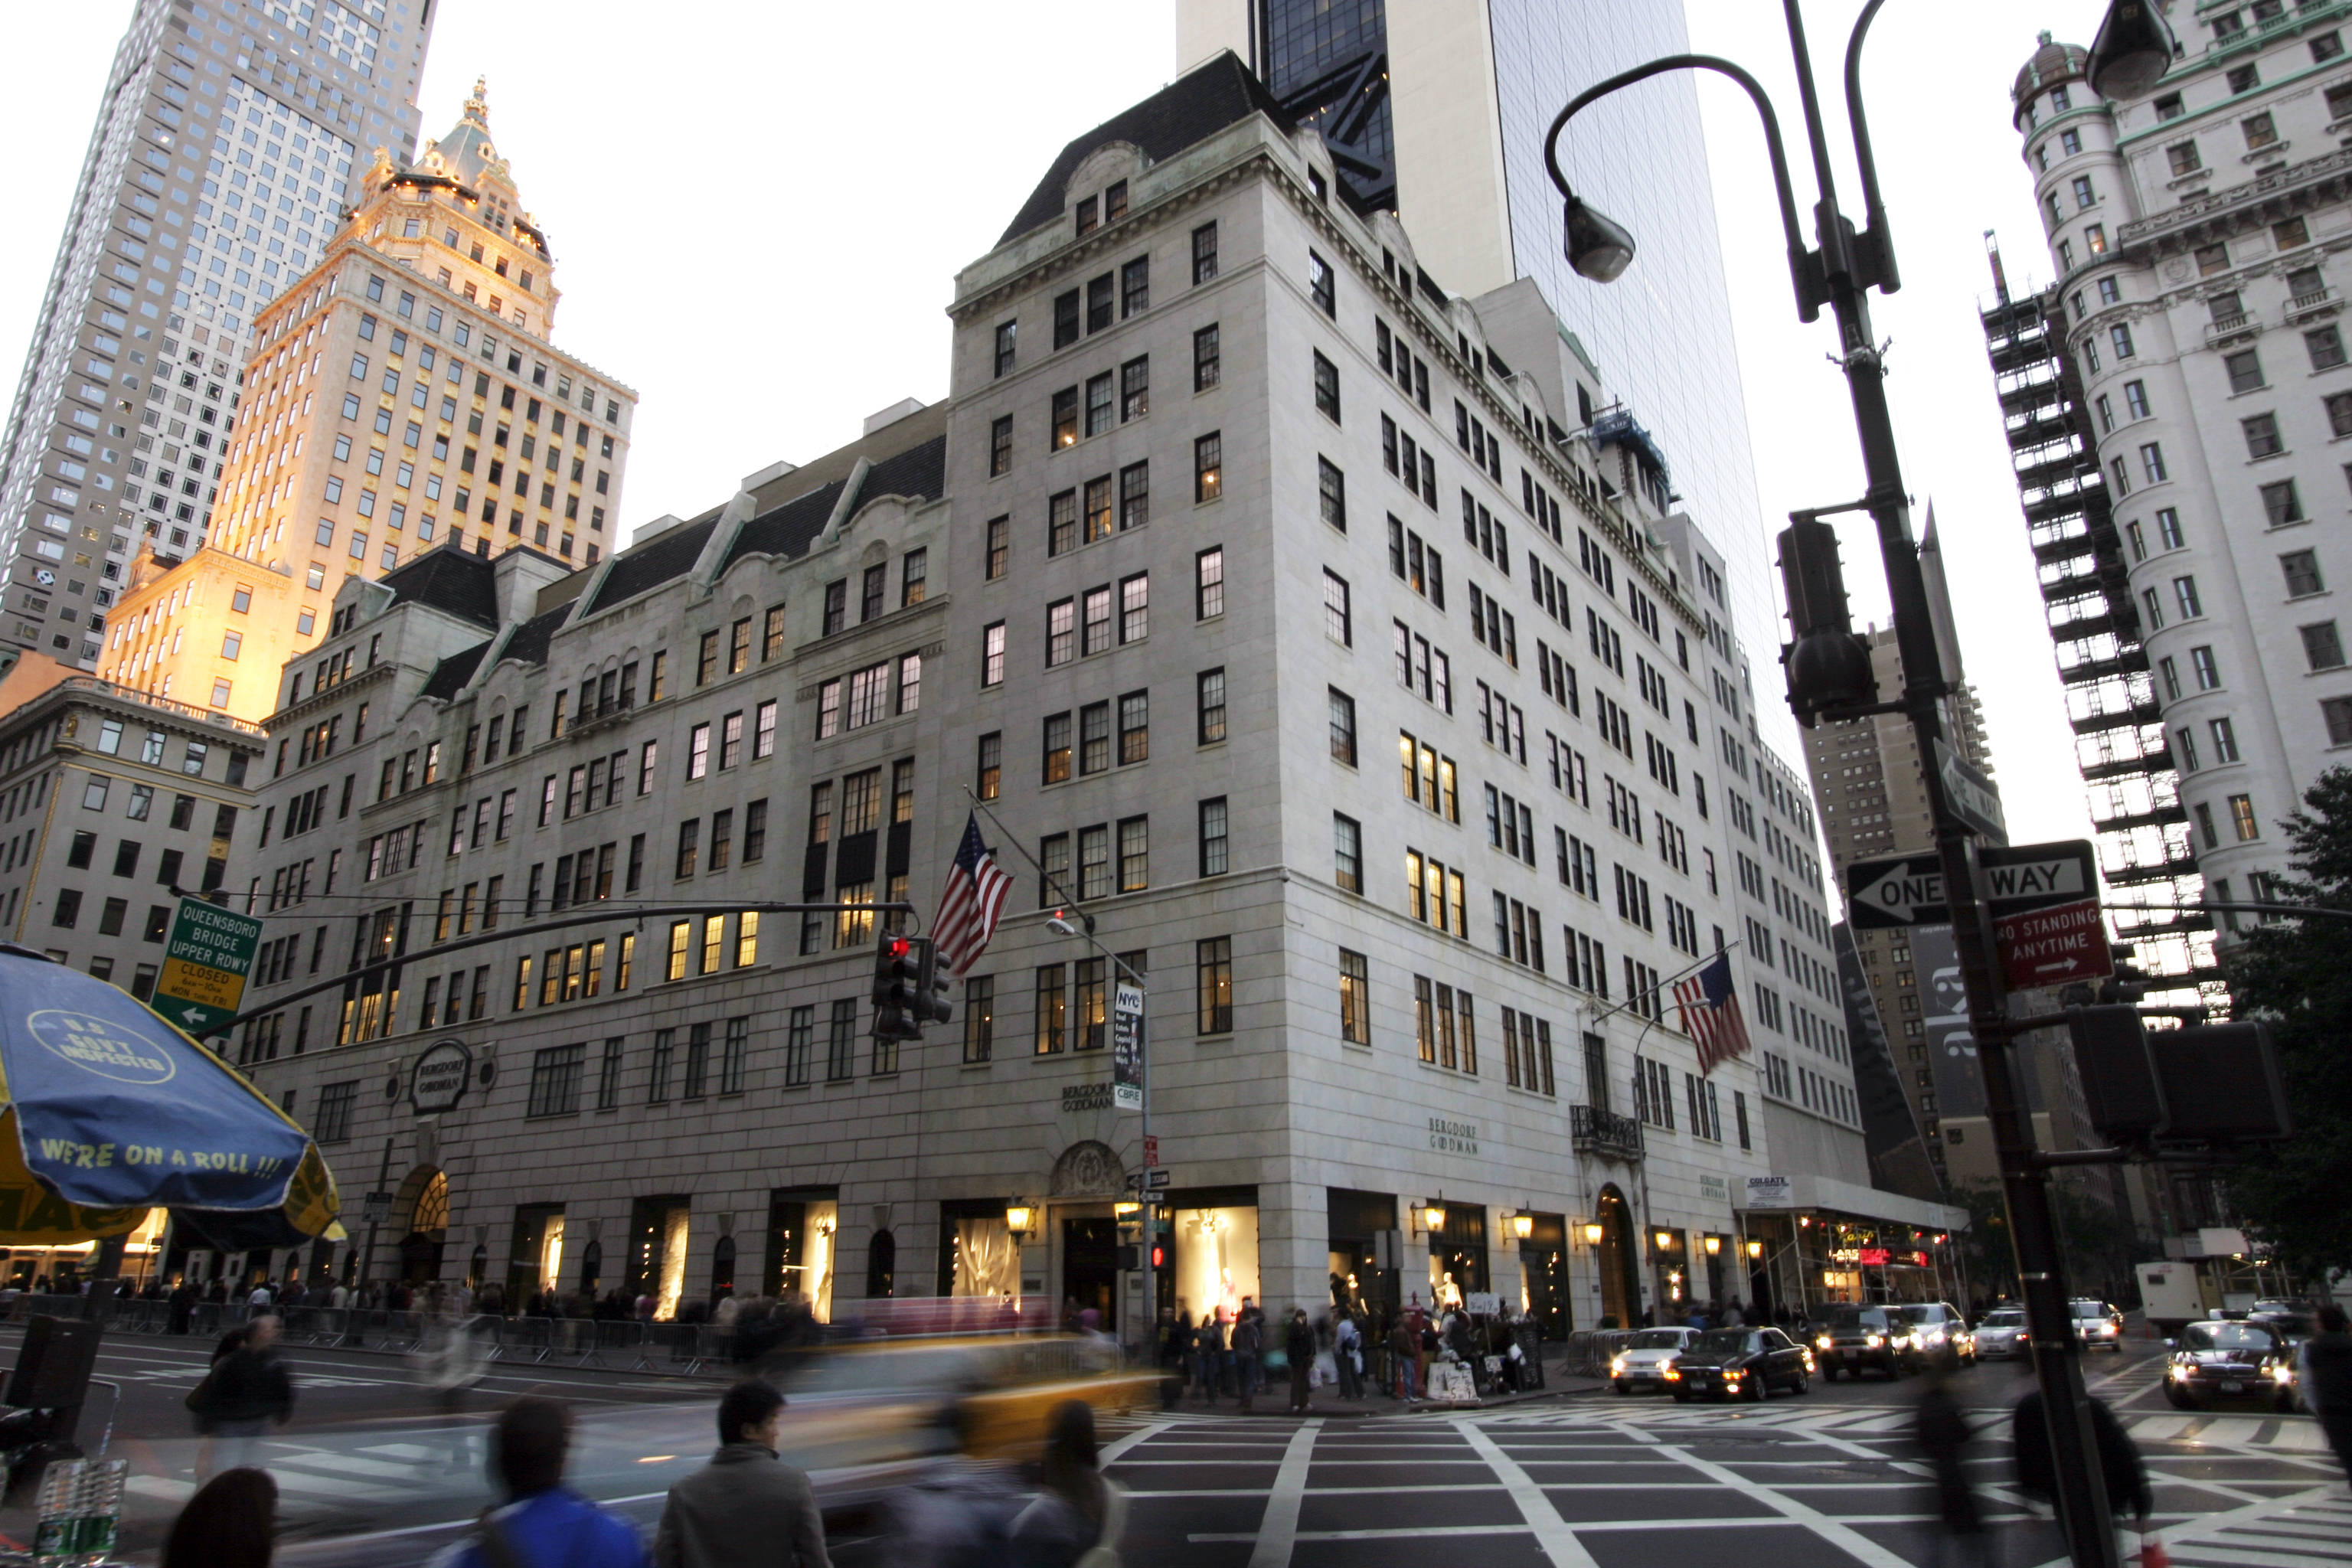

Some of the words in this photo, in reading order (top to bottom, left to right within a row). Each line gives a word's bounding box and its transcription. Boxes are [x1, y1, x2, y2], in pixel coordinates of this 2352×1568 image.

[1949, 769, 1970, 805] ONE
[1979, 792, 1998, 825] WAY
[1880, 877, 1945, 906] ONE
[1991, 864, 2061, 896] WAY
[183, 906, 257, 939] QUEENSBORO
[2023, 908, 2096, 937] STANDING
[192, 927, 239, 952] BRIDGE
[2013, 933, 2089, 962] ANYTIME
[172, 941, 213, 962] UPPER
[215, 952, 250, 972] RDWY
[181, 963, 230, 985] CLOSED
[171, 985, 191, 996] MON
[212, 995, 228, 1007] FRI
[1118, 991, 1139, 1008] NYC
[58, 1044, 166, 1071] INSPECTED
[1063, 1082, 1114, 1099] BERGDORF
[1117, 1088, 1140, 1101] CBRE
[1063, 1096, 1113, 1112] GOODMAN
[1429, 1117, 1476, 1138] BERGDORF
[1430, 1135, 1478, 1155] GOODMAN
[125, 1145, 163, 1165] ON
[171, 1149, 188, 1166] A
[191, 1152, 249, 1174] ROLL
[1749, 1176, 1785, 1184] COLGATE
